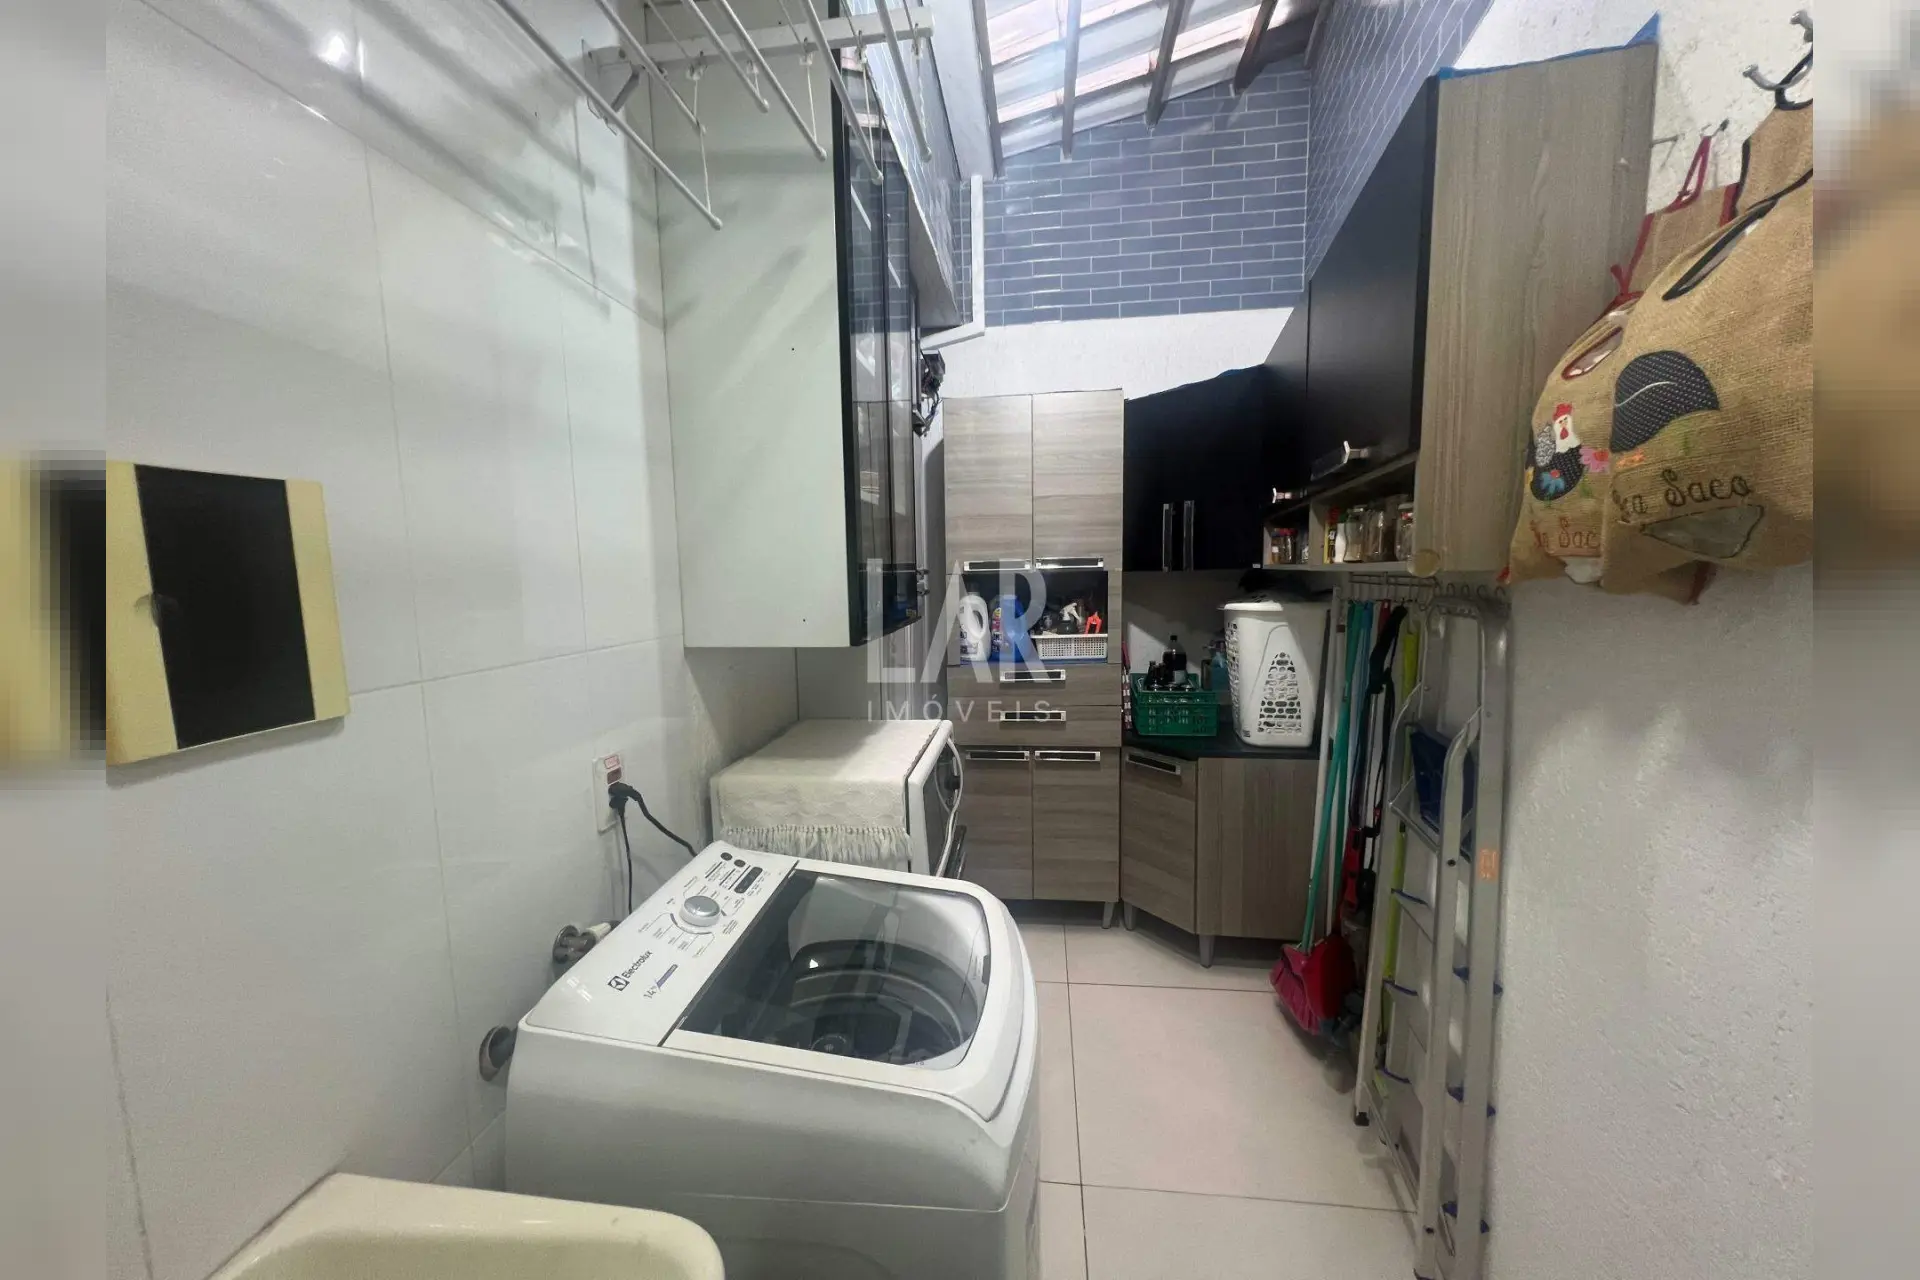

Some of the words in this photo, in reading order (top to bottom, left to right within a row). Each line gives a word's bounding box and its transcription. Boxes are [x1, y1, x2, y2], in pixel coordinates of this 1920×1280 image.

[1662, 468, 1751, 507] Saco
[1559, 515, 1600, 549] Sac
[621, 950, 653, 979] Electrolux
